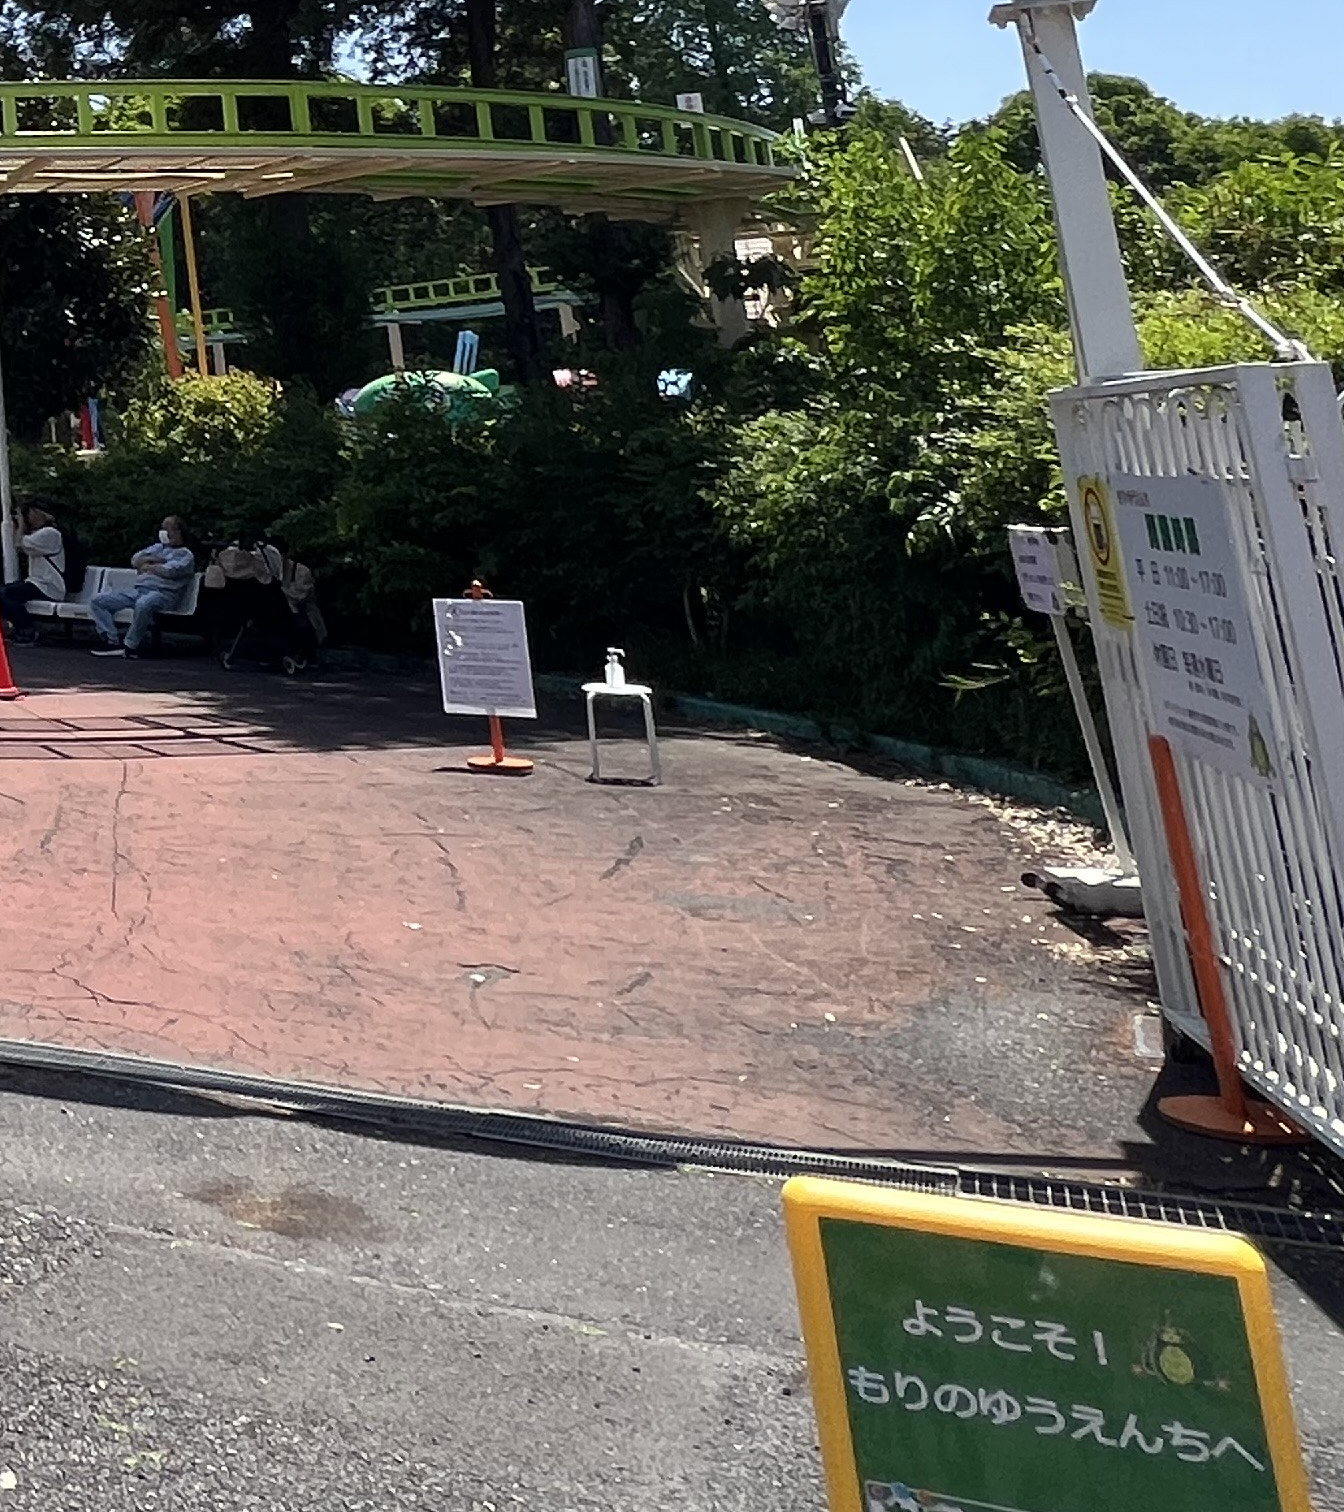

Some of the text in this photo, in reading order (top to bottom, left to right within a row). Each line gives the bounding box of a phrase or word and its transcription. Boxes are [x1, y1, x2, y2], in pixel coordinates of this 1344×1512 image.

[848, 1364, 1267, 1473] もりのゆうえんちへ
